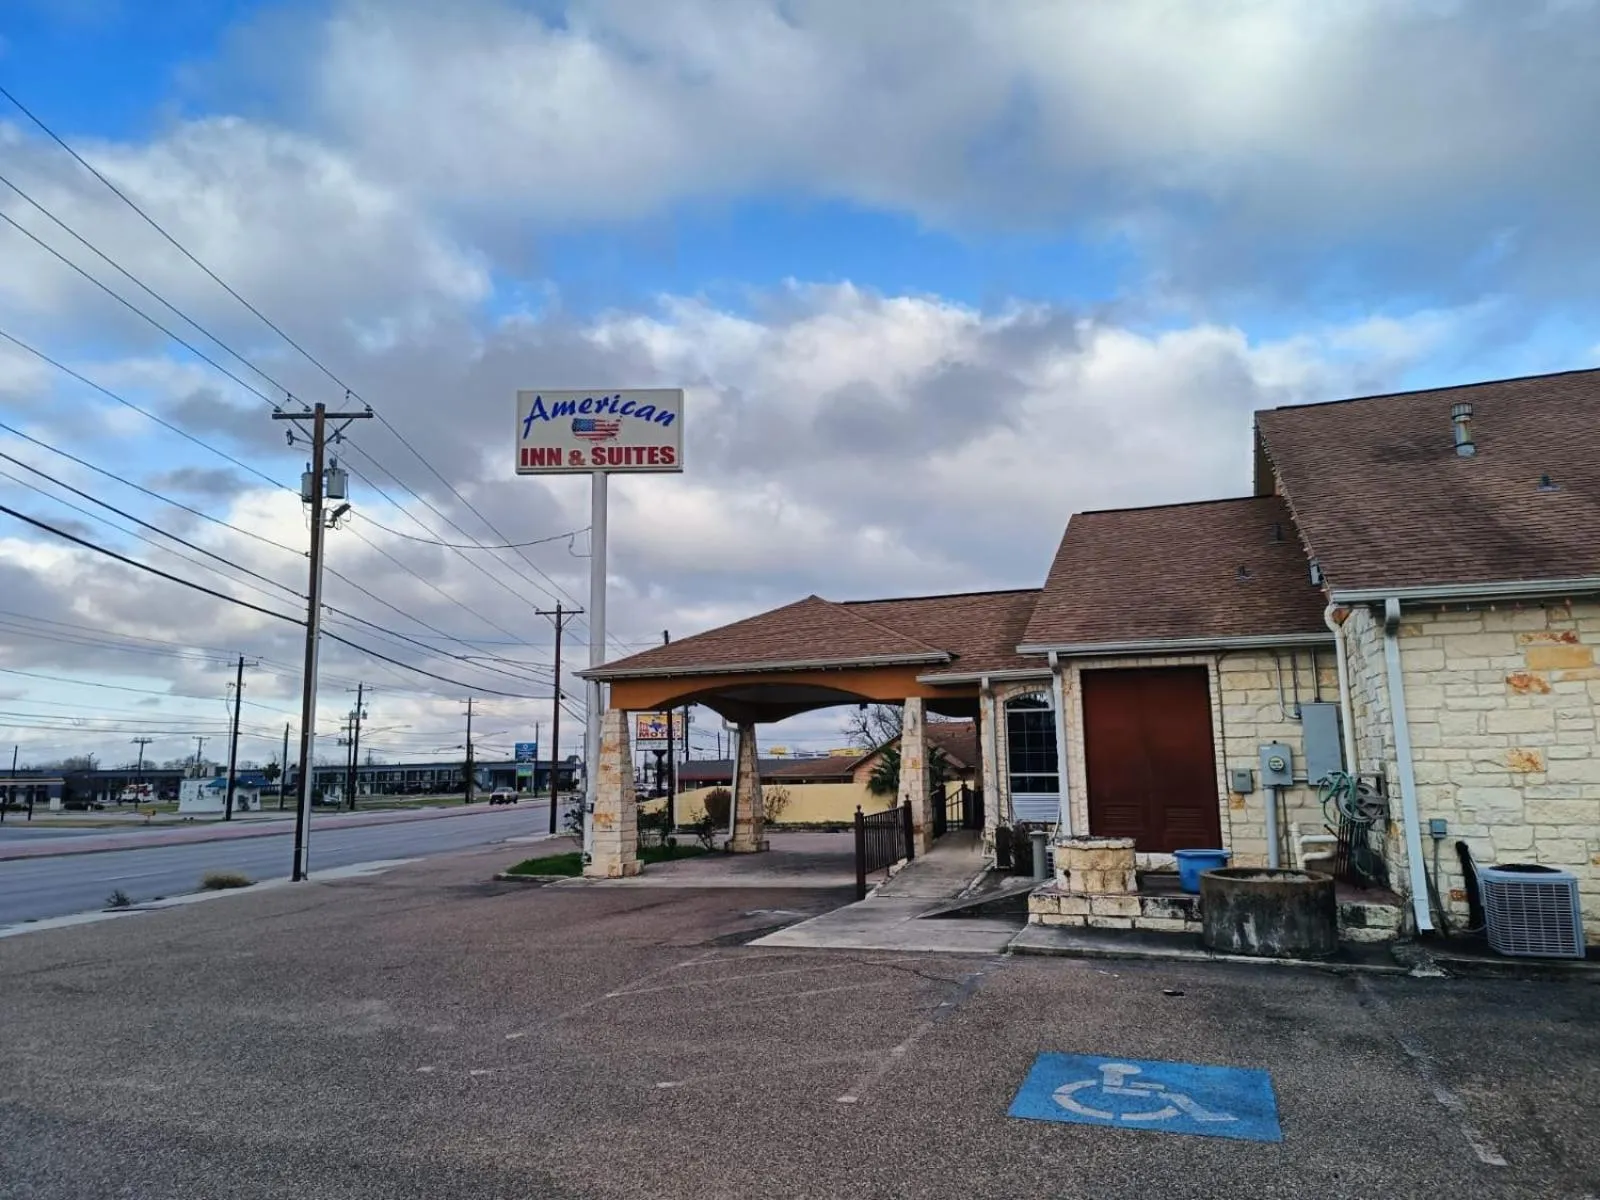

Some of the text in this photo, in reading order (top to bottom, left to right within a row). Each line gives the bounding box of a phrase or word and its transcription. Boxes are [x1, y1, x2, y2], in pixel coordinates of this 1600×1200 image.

[523, 395, 675, 439] American
[521, 446, 675, 467] INN & SUITES
